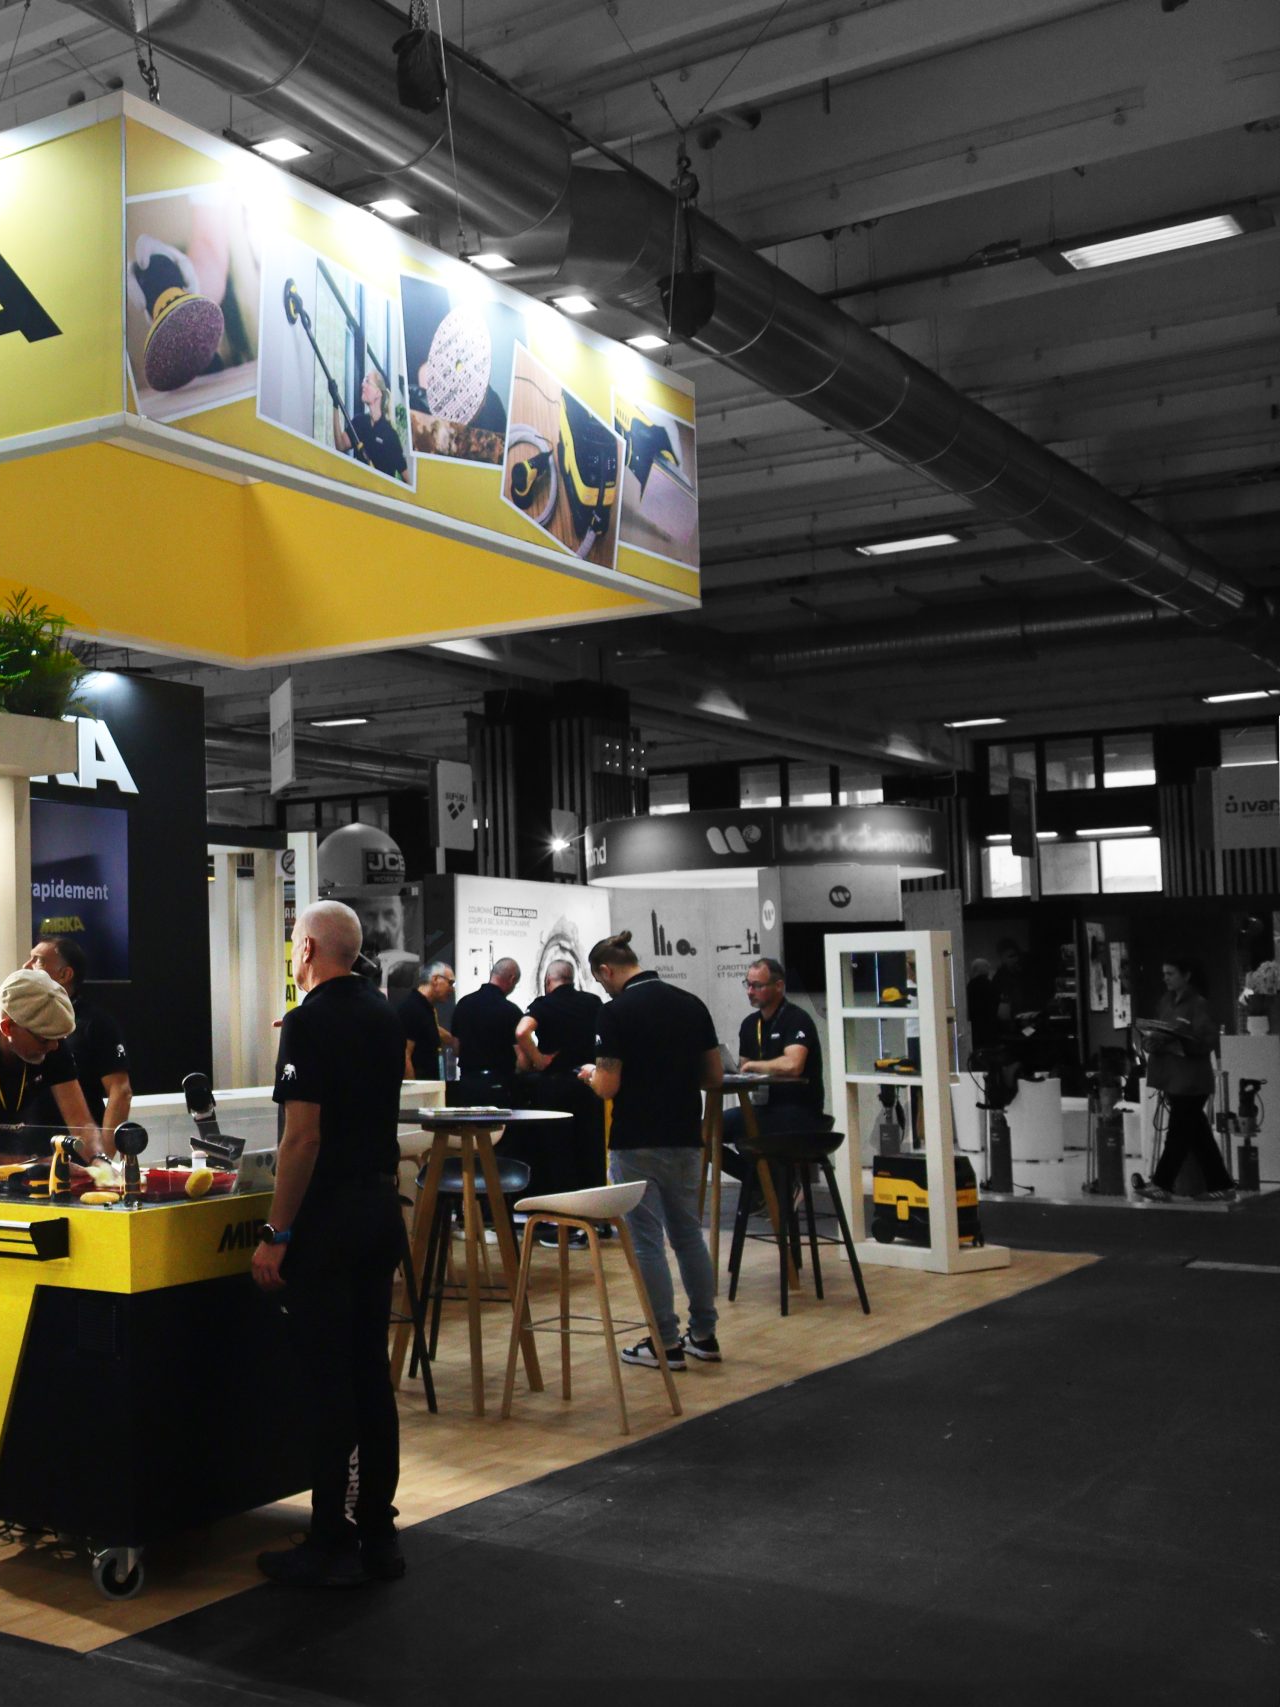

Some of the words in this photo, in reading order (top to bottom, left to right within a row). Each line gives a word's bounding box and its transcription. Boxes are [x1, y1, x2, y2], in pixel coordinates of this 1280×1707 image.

[368, 852, 405, 871] JCB
[39, 916, 85, 933] MIRKA
[344, 1444, 359, 1525] MIRKA
